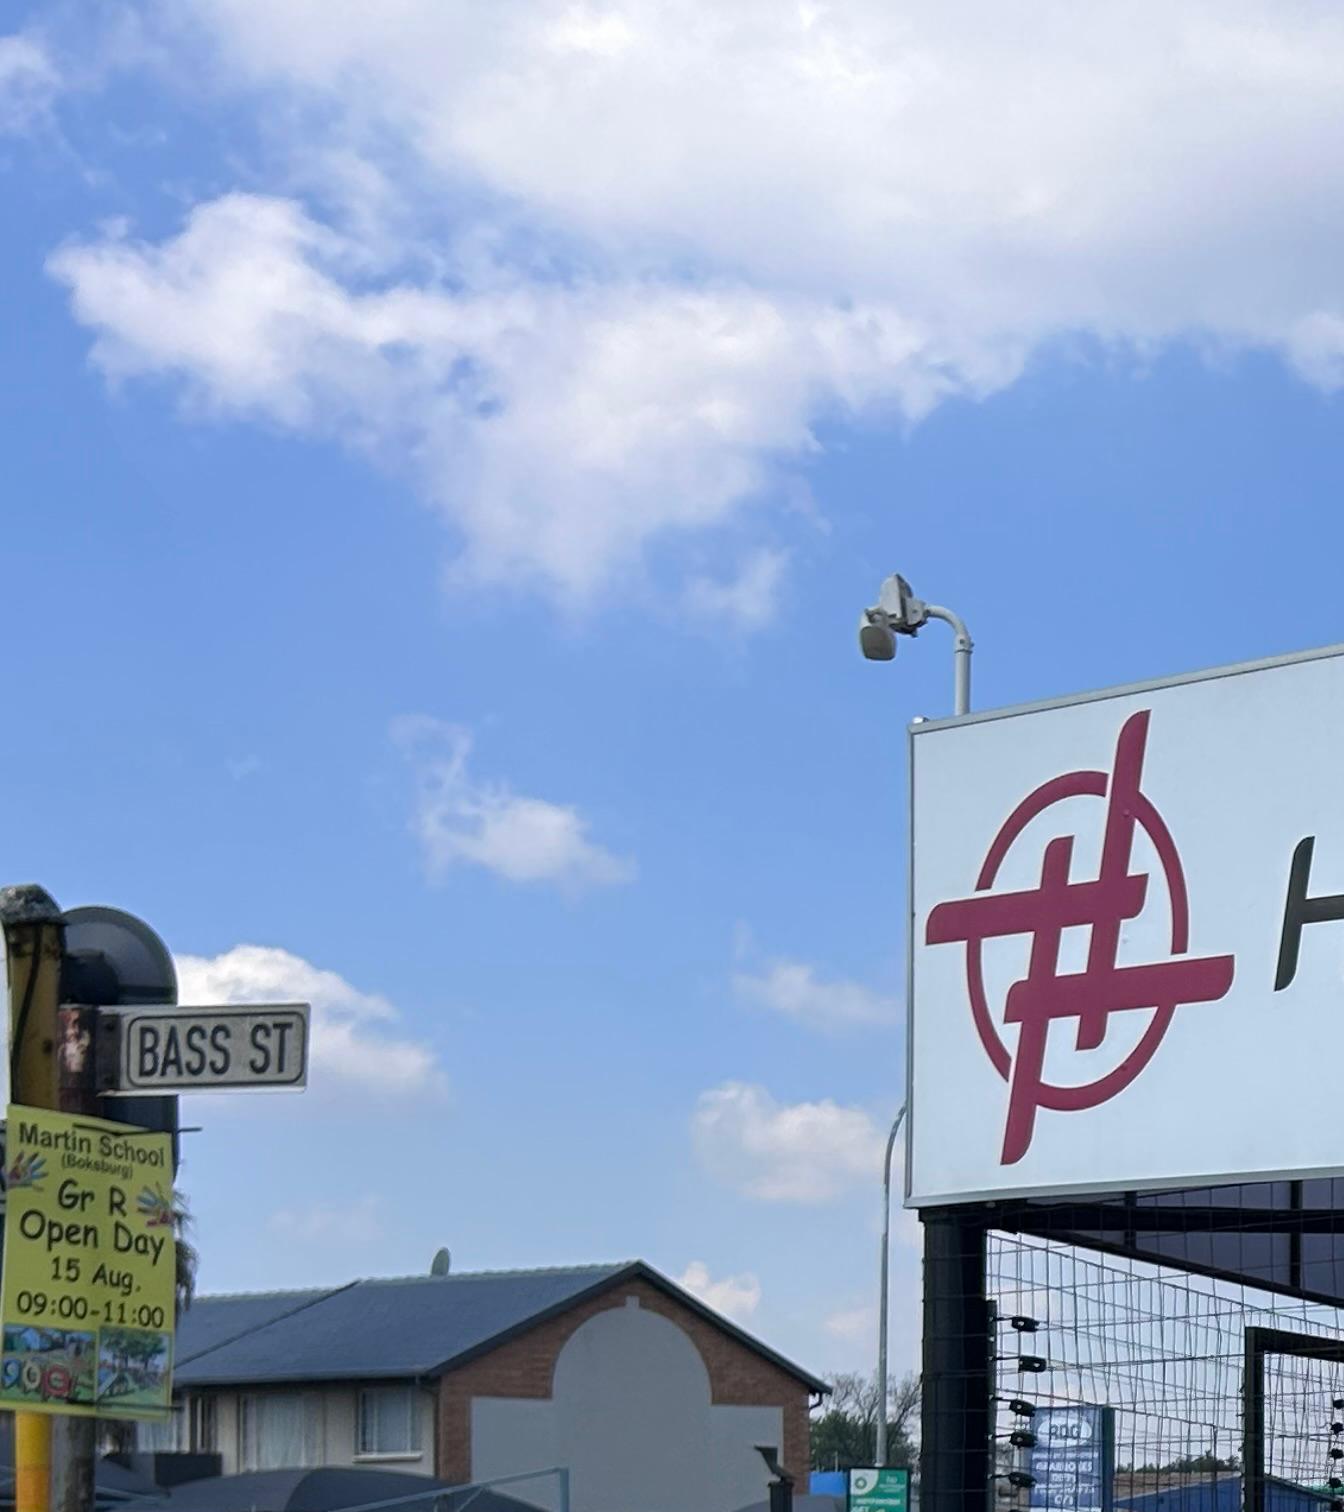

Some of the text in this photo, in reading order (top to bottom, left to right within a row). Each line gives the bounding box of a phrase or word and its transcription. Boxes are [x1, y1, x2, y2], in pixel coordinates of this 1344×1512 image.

[138, 1021, 294, 1078] BASS ST
[19, 1121, 166, 1168] Martin School
[61, 1152, 134, 1180] (Boksburg)
[57, 1178, 128, 1218] Gr R
[19, 1208, 166, 1266] Open Day
[51, 1256, 81, 1282] 15
[16, 1290, 165, 1329] 09:00-11:00
